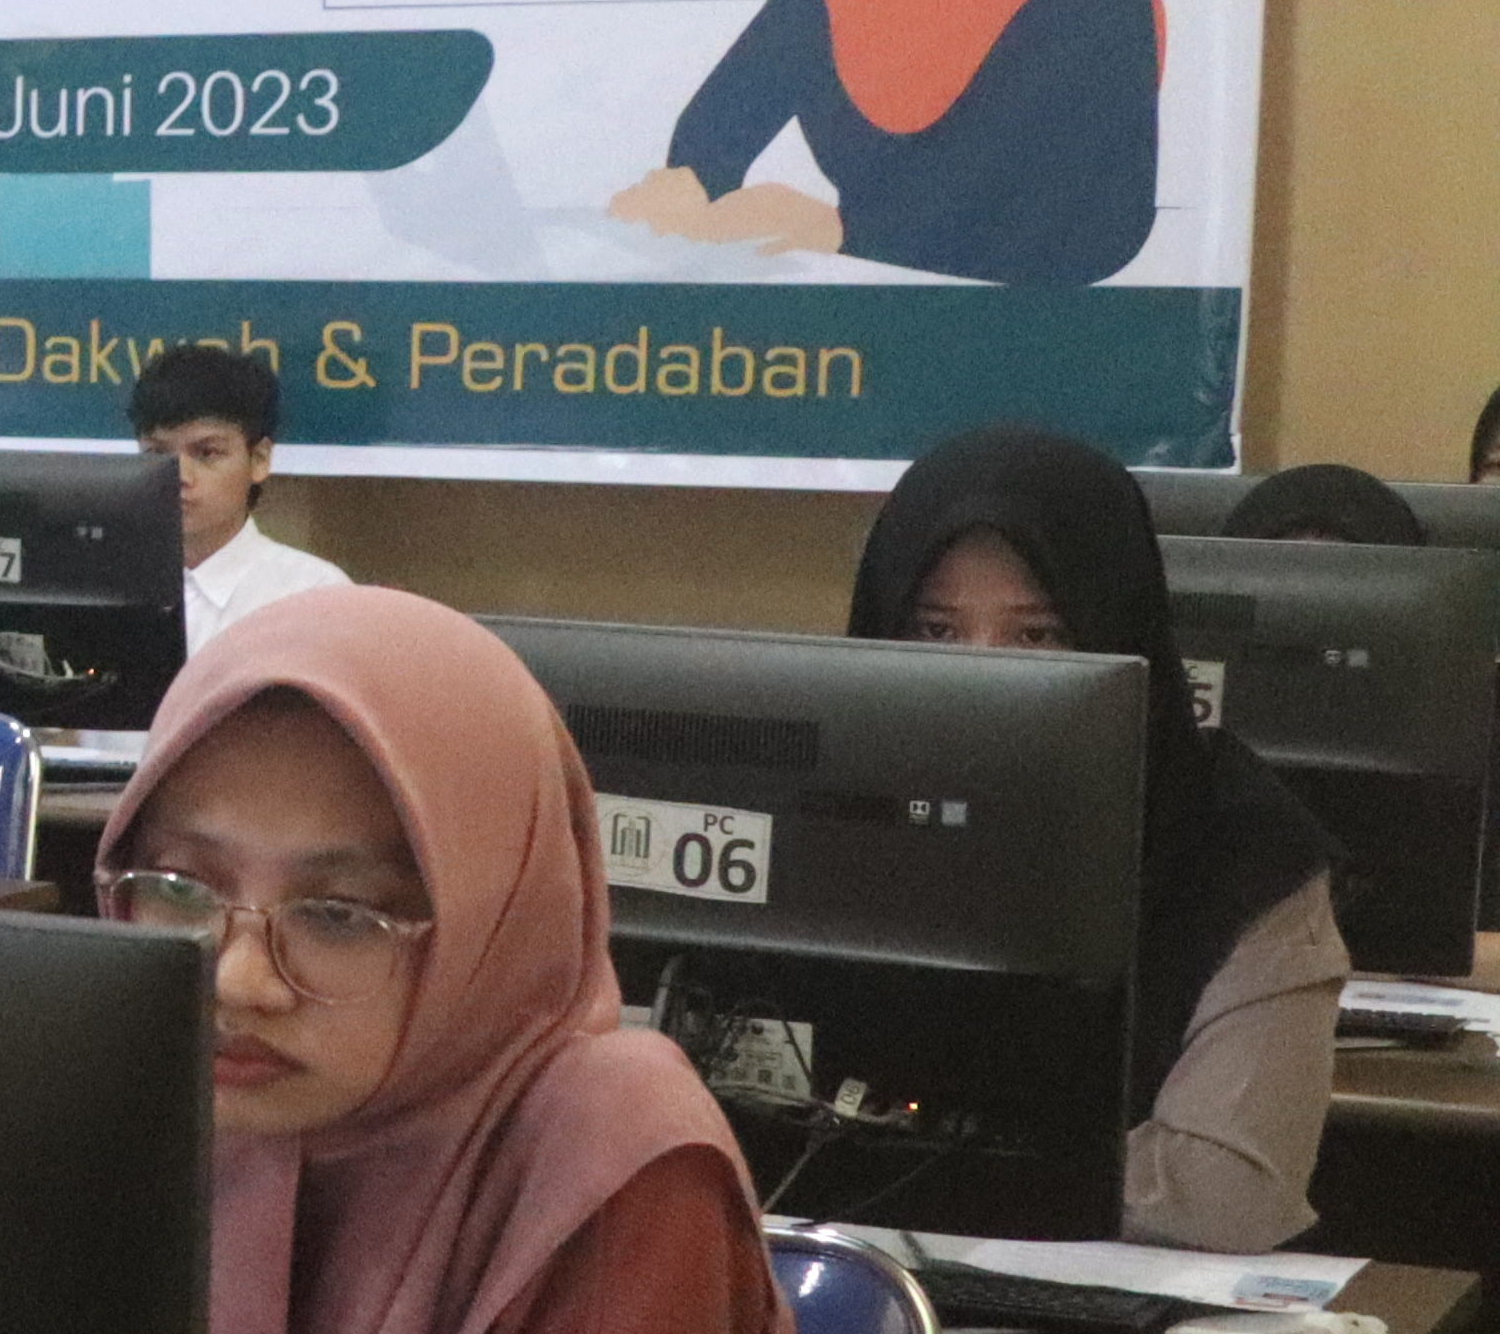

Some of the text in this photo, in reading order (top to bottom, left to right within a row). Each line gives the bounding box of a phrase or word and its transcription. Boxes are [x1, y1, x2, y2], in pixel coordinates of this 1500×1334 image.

[155, 69, 340, 137] 2023
[315, 320, 376, 389] &
[409, 322, 862, 398] Peradaban
[1187, 682, 1212, 723] 5
[703, 813, 736, 835] PC
[673, 832, 756, 893] 06
